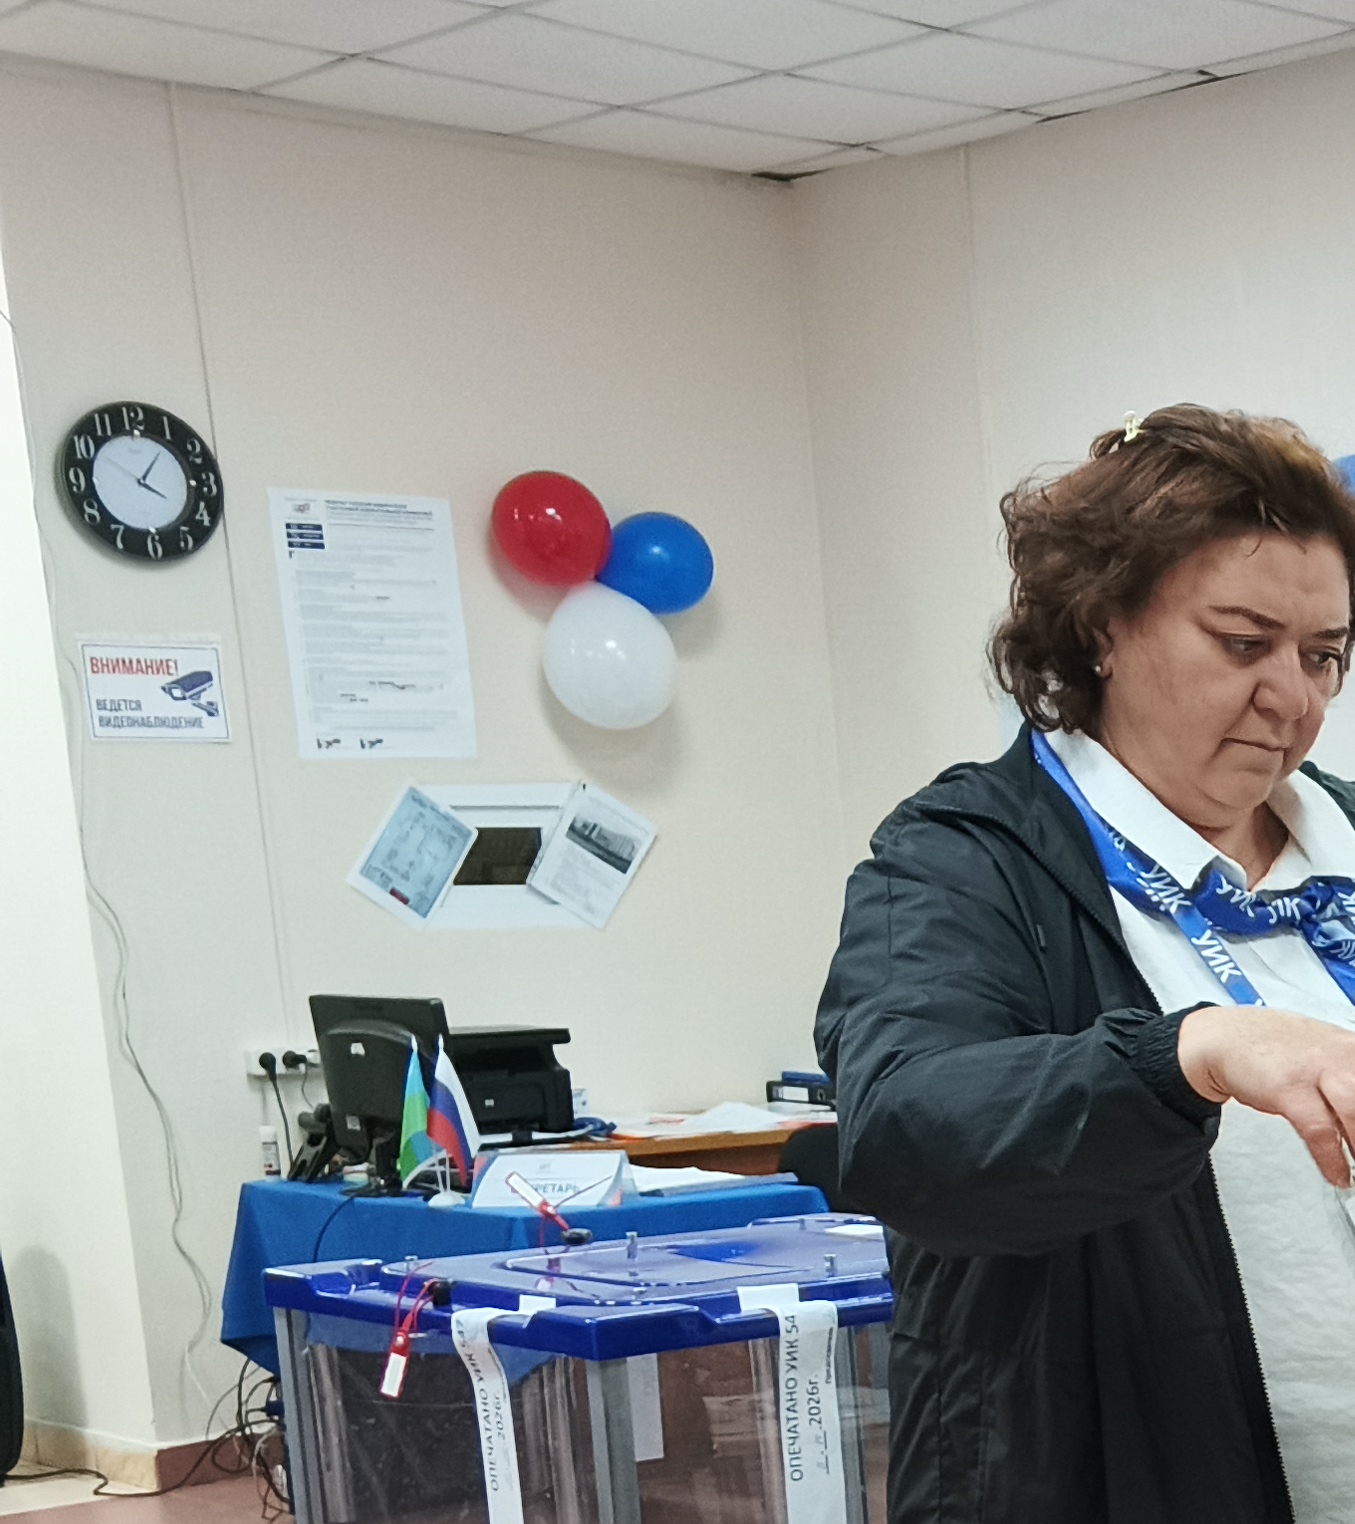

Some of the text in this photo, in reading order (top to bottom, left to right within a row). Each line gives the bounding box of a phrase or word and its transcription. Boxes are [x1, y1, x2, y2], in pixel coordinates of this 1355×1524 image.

[94, 413, 112, 436] 11
[122, 406, 145, 430] 12
[162, 416, 171, 440] 1
[73, 435, 95, 459] 10
[186, 438, 203, 464] 2
[69, 467, 86, 493] 9
[202, 472, 218, 496] 3
[83, 499, 100, 524] 8
[195, 501, 211, 526] 4
[110, 524, 125, 549] 7
[146, 532, 163, 560] 6
[179, 526, 193, 550] 5
[89, 656, 179, 676] ВНИМАНИЕ!
[96, 698, 142, 712] ВЕДЕТСЯ
[98, 715, 204, 729] ВИДЕОНАБЛЮДЕНИЕ
[1139, 863, 1192, 914] УИК
[1191, 929, 1242, 984] УИК
[464, 1352, 486, 1384] УИК
[785, 1338, 799, 1375] УИК
[477, 1387, 499, 1492] ОПЕЧАТАНО
[785, 1377, 804, 1482] ОПЕЧАТАНО
